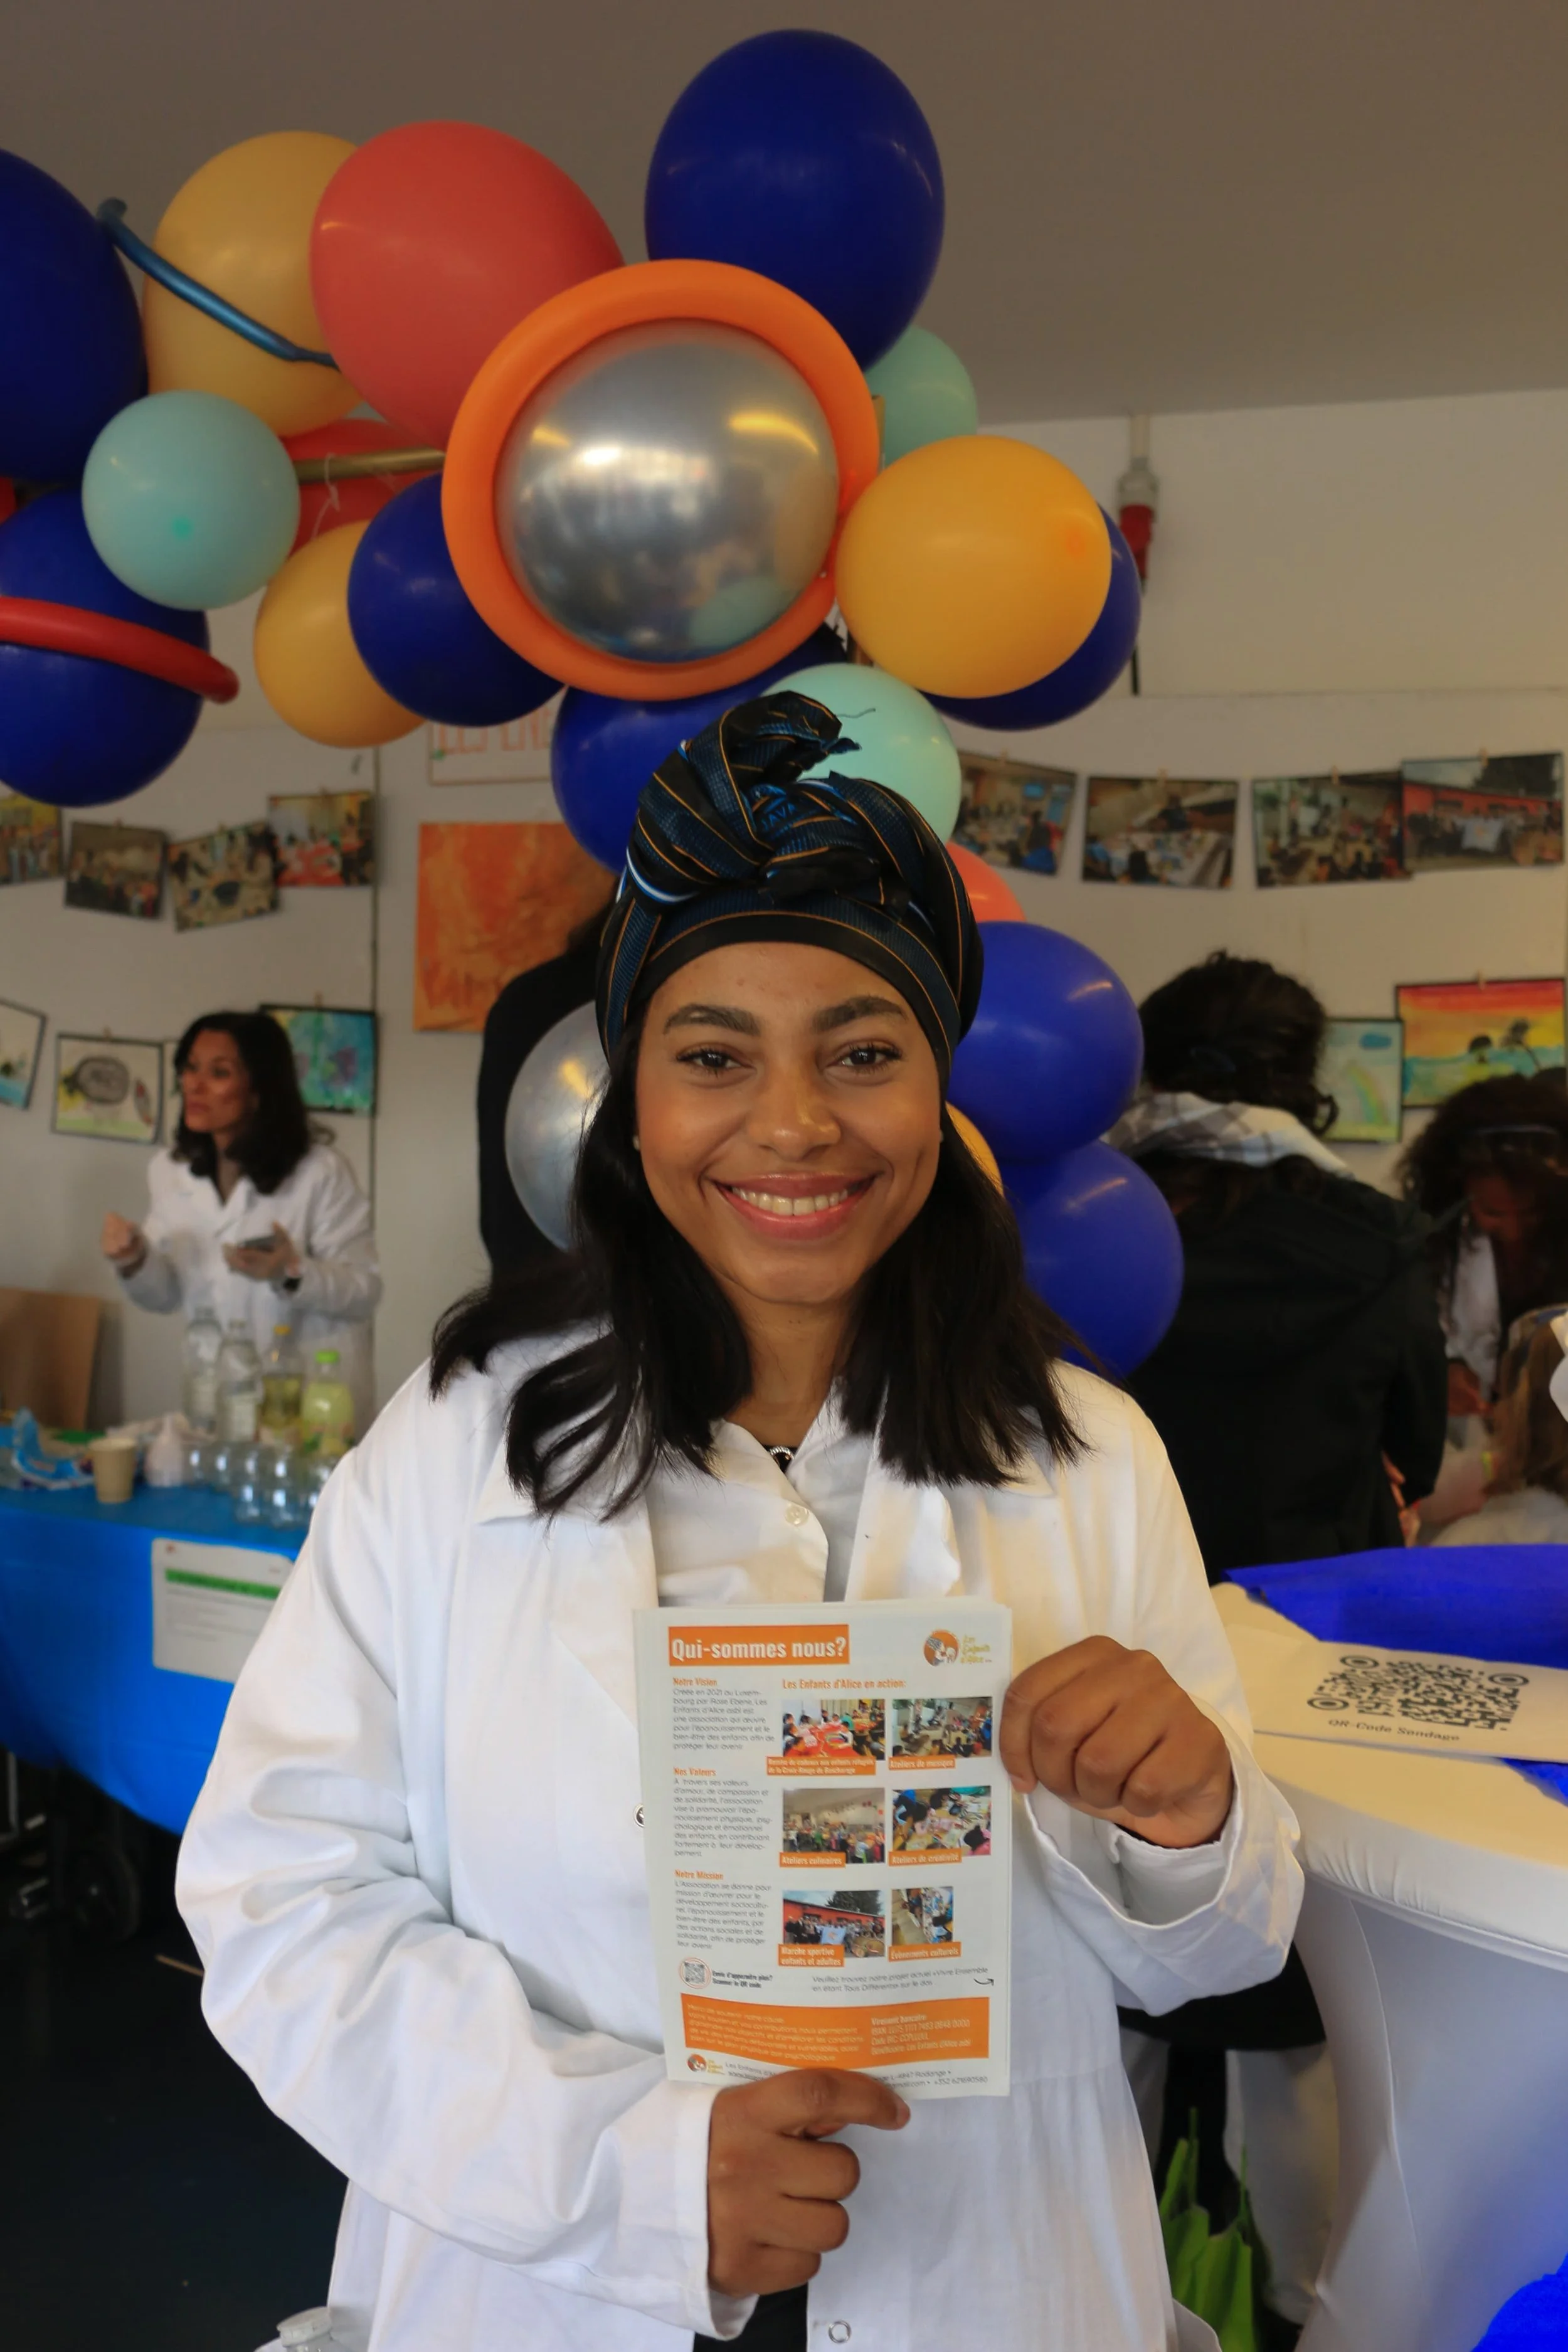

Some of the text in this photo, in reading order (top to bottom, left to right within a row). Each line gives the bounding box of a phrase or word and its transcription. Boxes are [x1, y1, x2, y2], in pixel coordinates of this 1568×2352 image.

[672, 1636, 846, 1662] Qui-sommes nous?
[673, 1677, 717, 1686] Notre Vision
[783, 1679, 906, 1689] Les Enfants d'Alice en action:
[1397, 1727, 1460, 1741] Sondage
[890, 1759, 914, 1768] Ateliers
[927, 1759, 954, 1768] musique
[674, 1767, 716, 1776] Nos Valeurs
[782, 1857, 842, 1865] Ateliers culinaires
[893, 1855, 917, 1865] Ateliers
[675, 1869, 724, 1880] Notre Mission
[781, 1947, 834, 1957] Marche sportive
[931, 1947, 959, 1957] culturels
[781, 1957, 841, 1966] enfants et adultes
[955, 1967, 988, 1975] Ensemble
